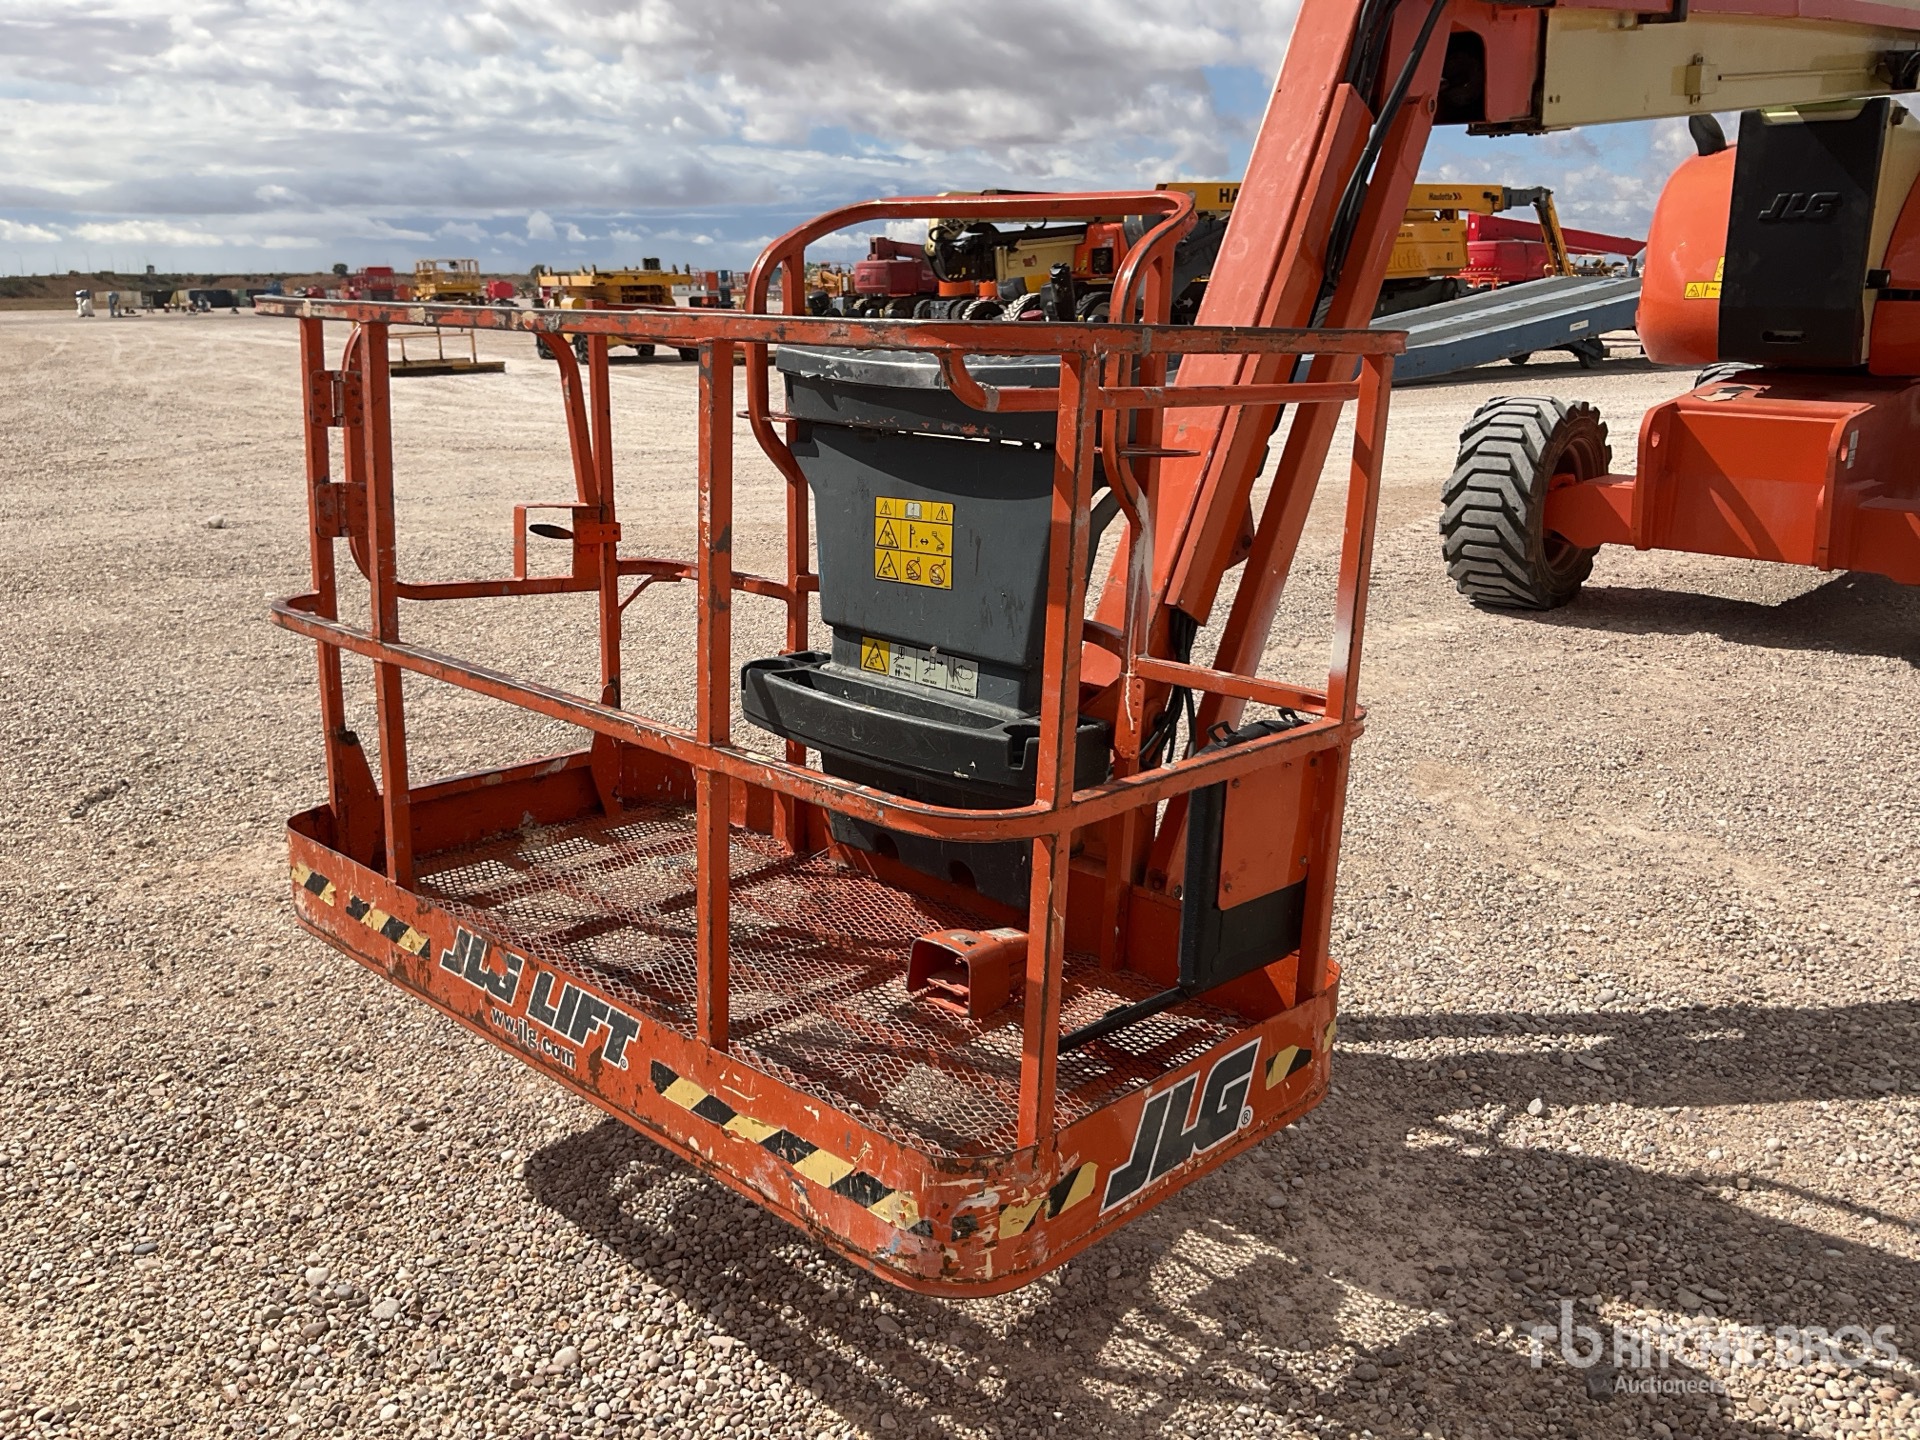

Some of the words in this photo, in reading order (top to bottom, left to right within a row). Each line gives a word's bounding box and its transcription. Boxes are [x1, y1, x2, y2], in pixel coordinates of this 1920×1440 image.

[1758, 192, 1842, 221] JLG
[440, 926, 525, 1006] JLG
[526, 970, 642, 1069] LIFT
[1098, 1036, 1262, 1216] JLG
